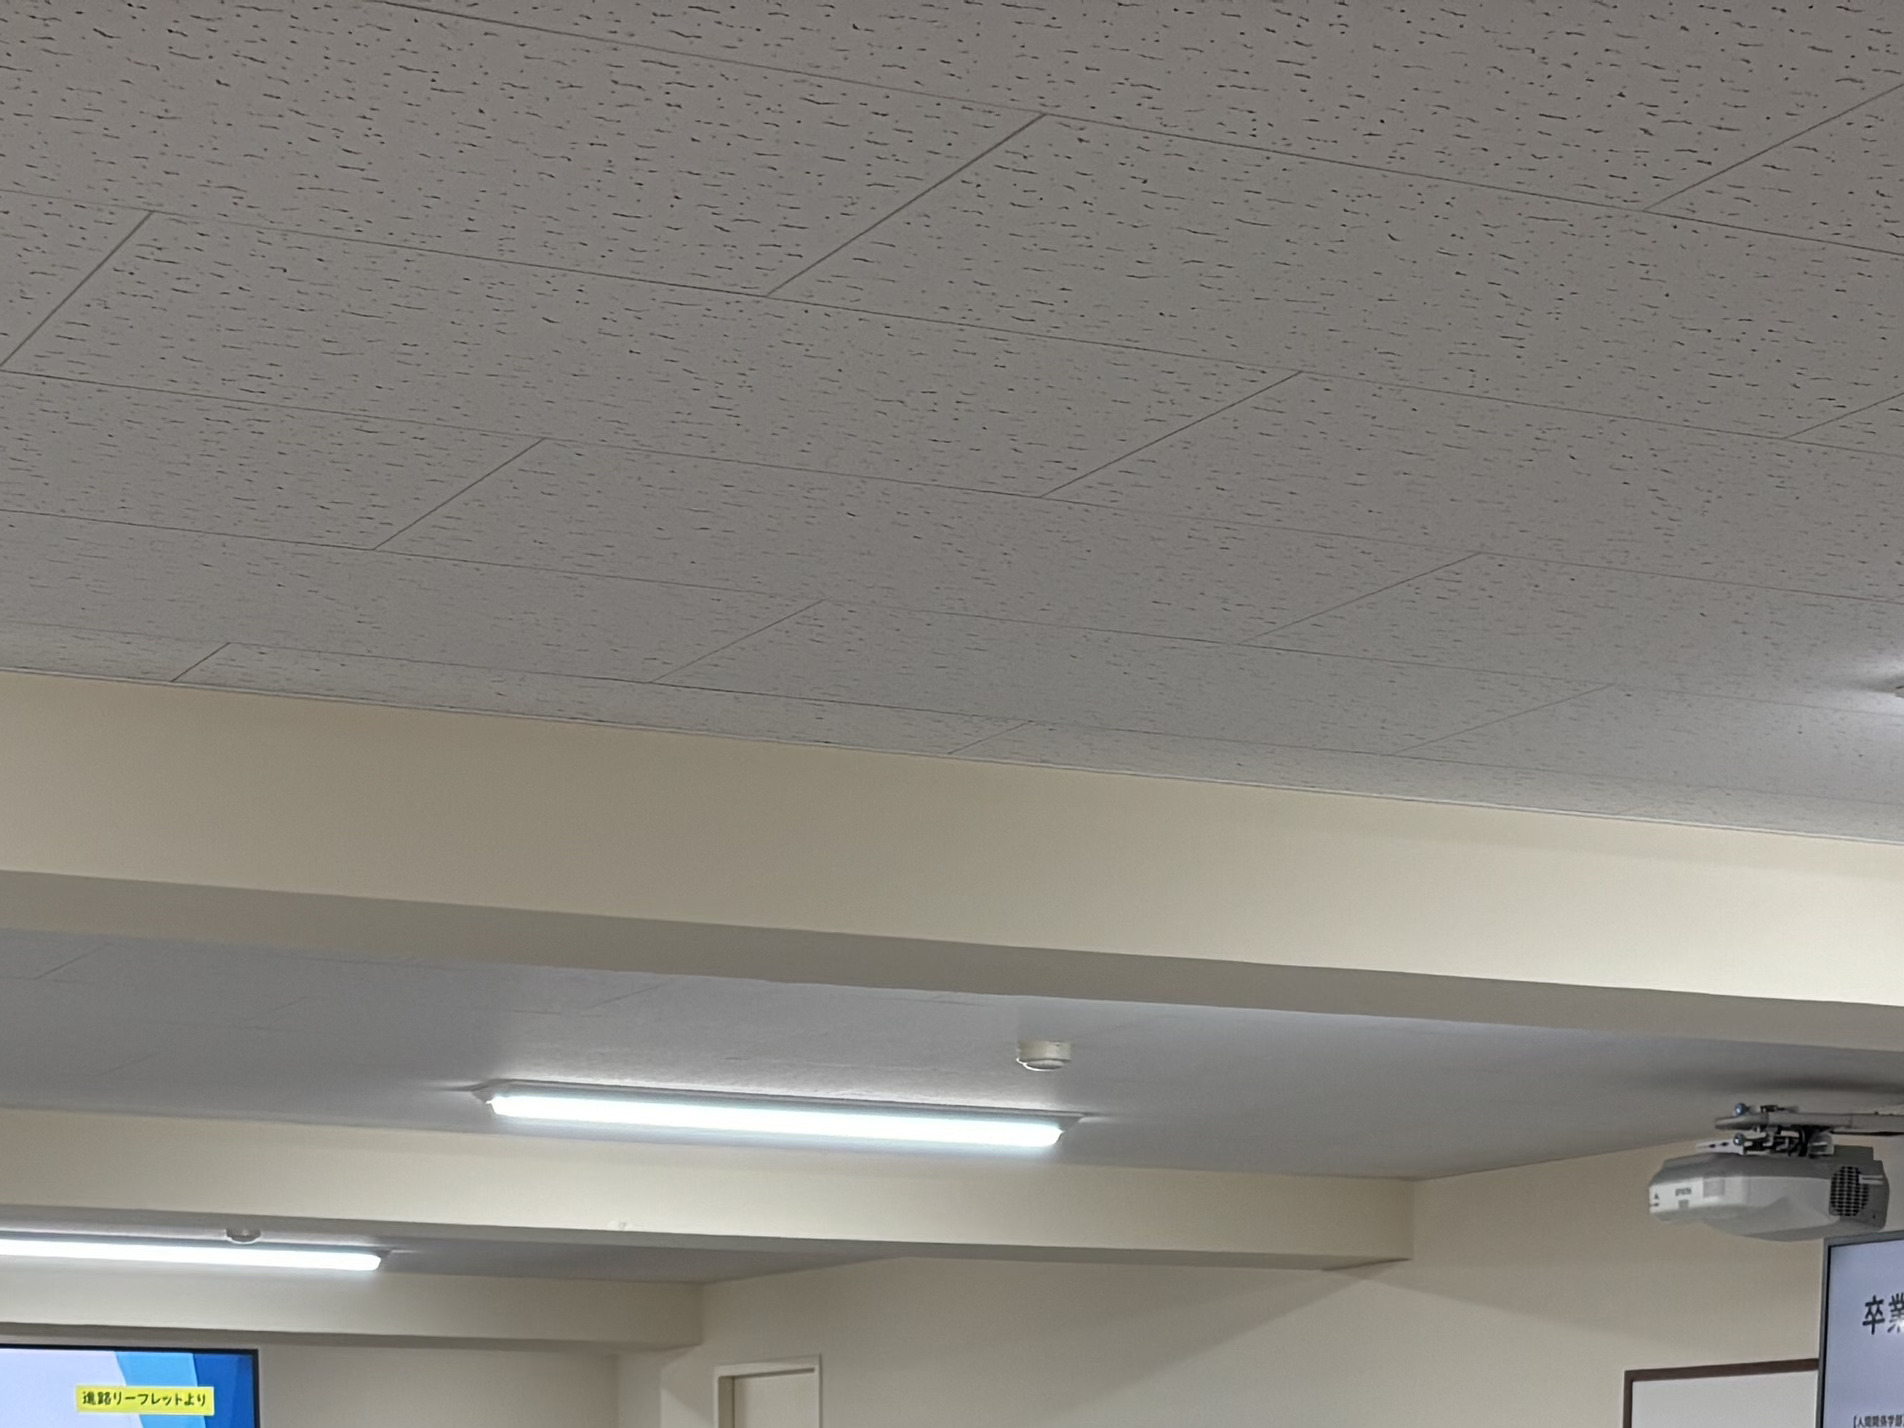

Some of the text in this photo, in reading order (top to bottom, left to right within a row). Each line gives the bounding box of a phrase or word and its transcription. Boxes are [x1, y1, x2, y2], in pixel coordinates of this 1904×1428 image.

[81, 1390, 208, 1407] 進路リーフレットより
